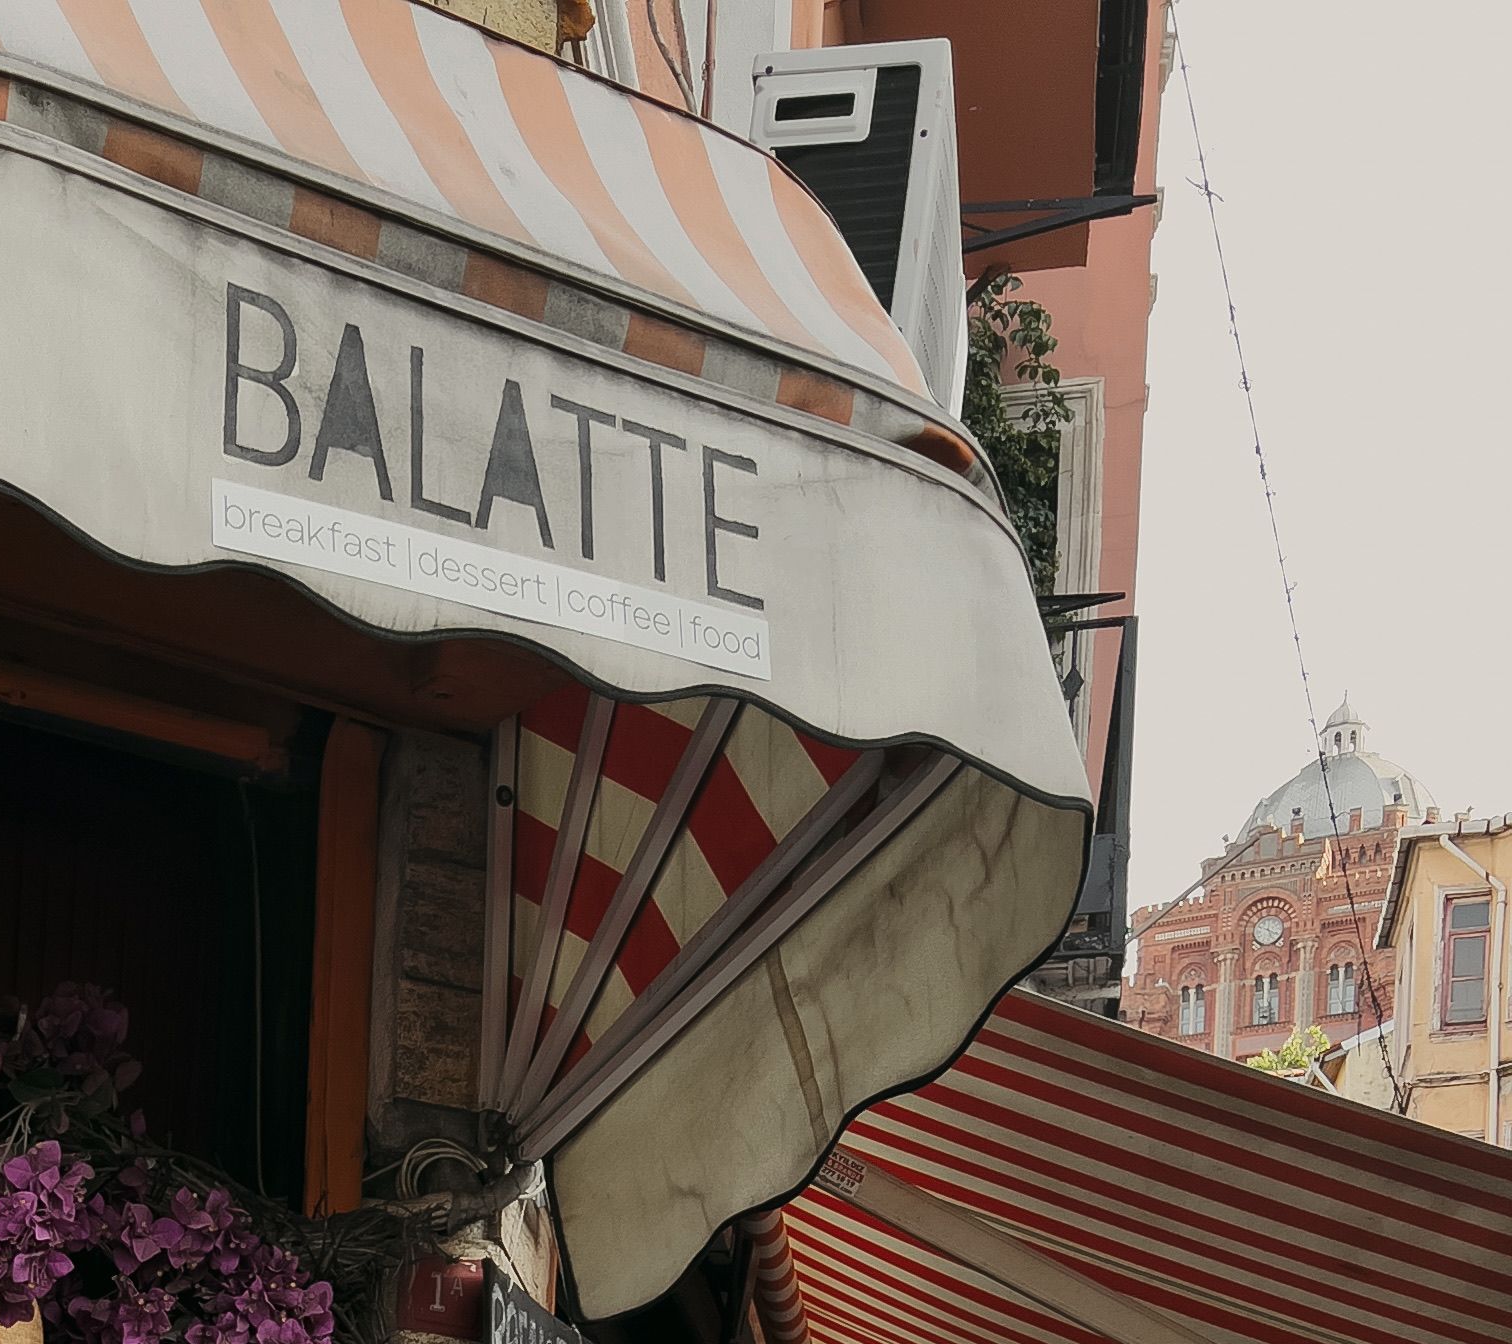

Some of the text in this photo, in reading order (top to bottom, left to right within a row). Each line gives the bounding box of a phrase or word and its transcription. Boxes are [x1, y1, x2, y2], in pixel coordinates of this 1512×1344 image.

[223, 281, 764, 610] BALATTE
[224, 496, 762, 660] breakfast dessert coffee food
